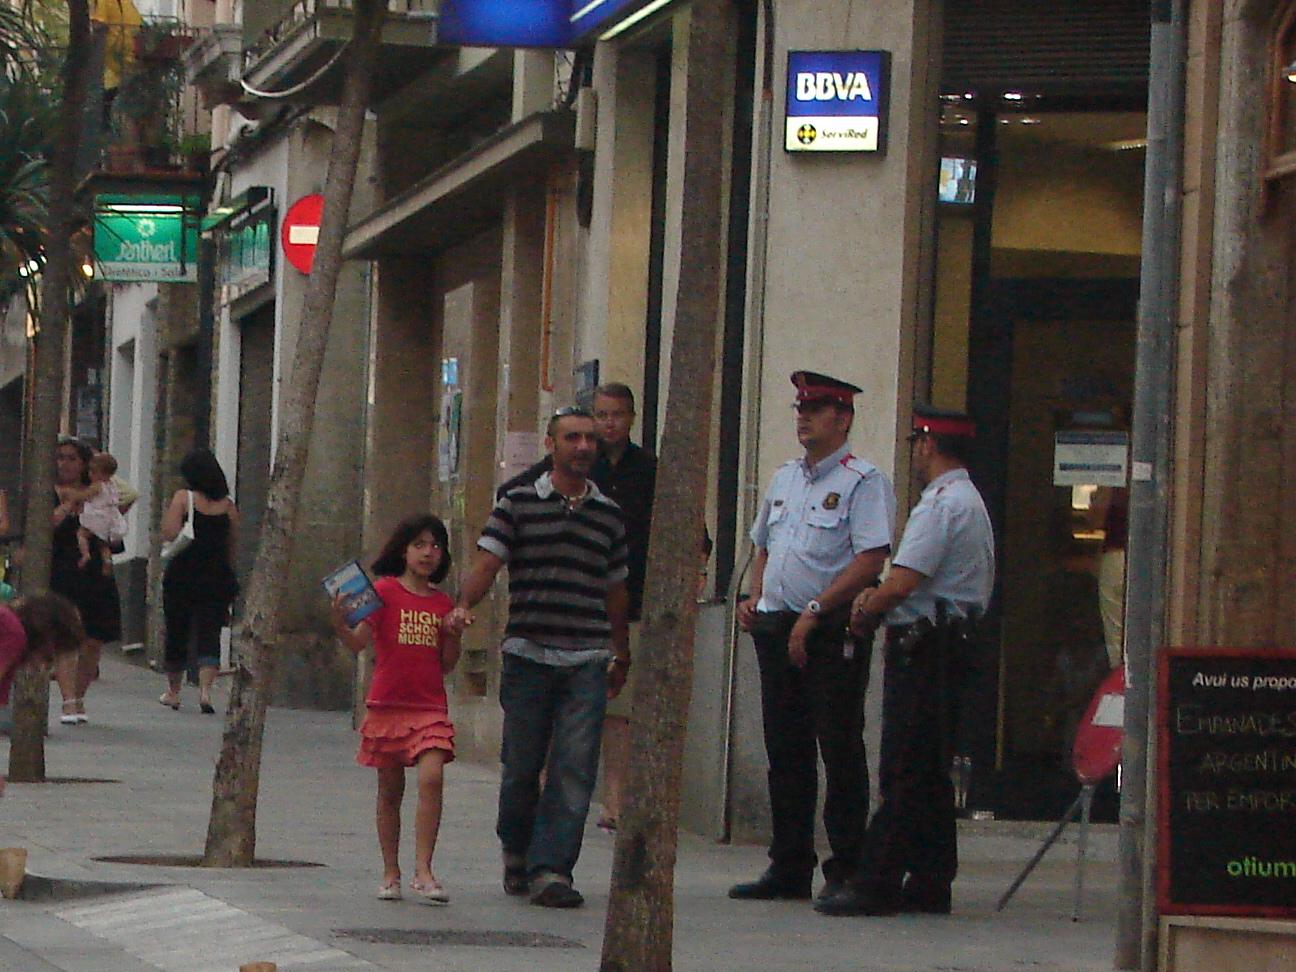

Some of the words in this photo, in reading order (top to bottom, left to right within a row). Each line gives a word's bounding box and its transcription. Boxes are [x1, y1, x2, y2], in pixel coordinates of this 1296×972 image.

[796, 72, 872, 101] BBVA
[821, 128, 868, 139] ServiRed
[401, 608, 442, 627] HIGH
[399, 622, 439, 636] SCHOO
[1192, 671, 1227, 688] Avui
[1231, 675, 1249, 688] us
[1227, 856, 1296, 877] otium
